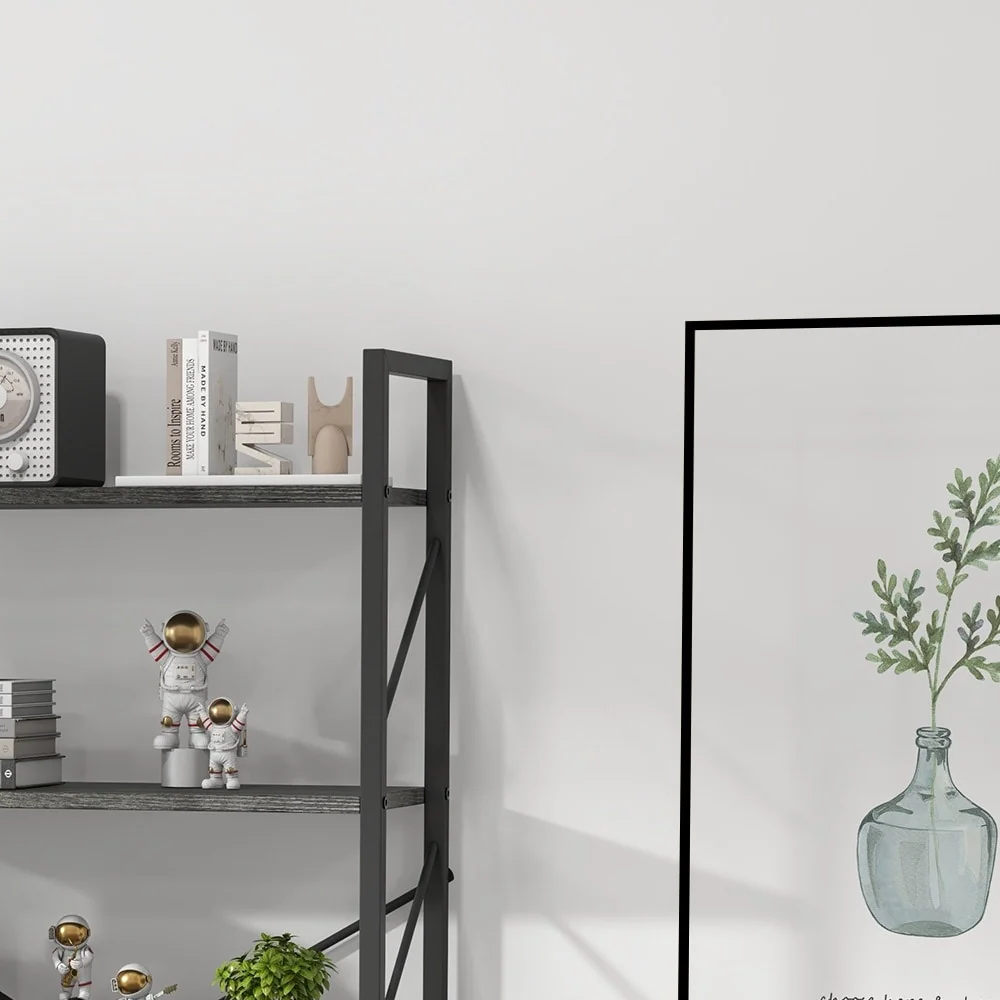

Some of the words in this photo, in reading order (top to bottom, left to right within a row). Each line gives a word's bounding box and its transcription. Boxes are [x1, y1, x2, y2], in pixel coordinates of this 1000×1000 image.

[186, 358, 195, 384] FRIENDS
[186, 384, 195, 405] AMONG
[200, 395, 206, 407] BY
[166, 398, 183, 427] Inspire
[186, 405, 195, 425] HOME
[169, 428, 181, 437] to
[186, 426, 195, 442] YOUR
[167, 439, 181, 468] Rooms
[186, 444, 195, 460] MAKE
